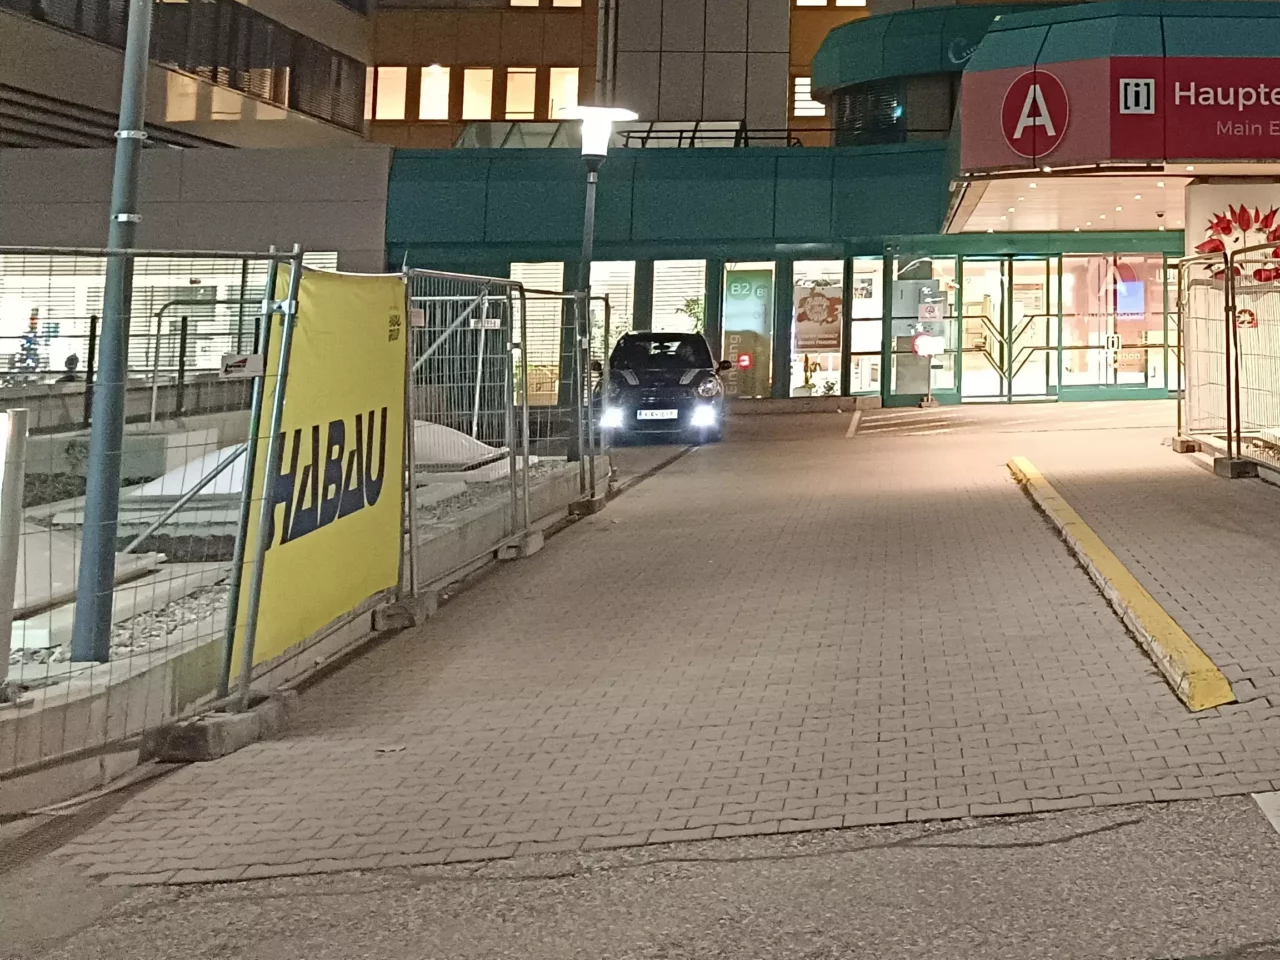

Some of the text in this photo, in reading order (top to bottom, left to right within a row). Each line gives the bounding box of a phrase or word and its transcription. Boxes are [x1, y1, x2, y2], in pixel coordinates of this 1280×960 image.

[1012, 84, 1056, 139] A
[1216, 120, 1262, 137] Main
[730, 282, 750, 296] B2
[264, 406, 389, 552] HABAU
